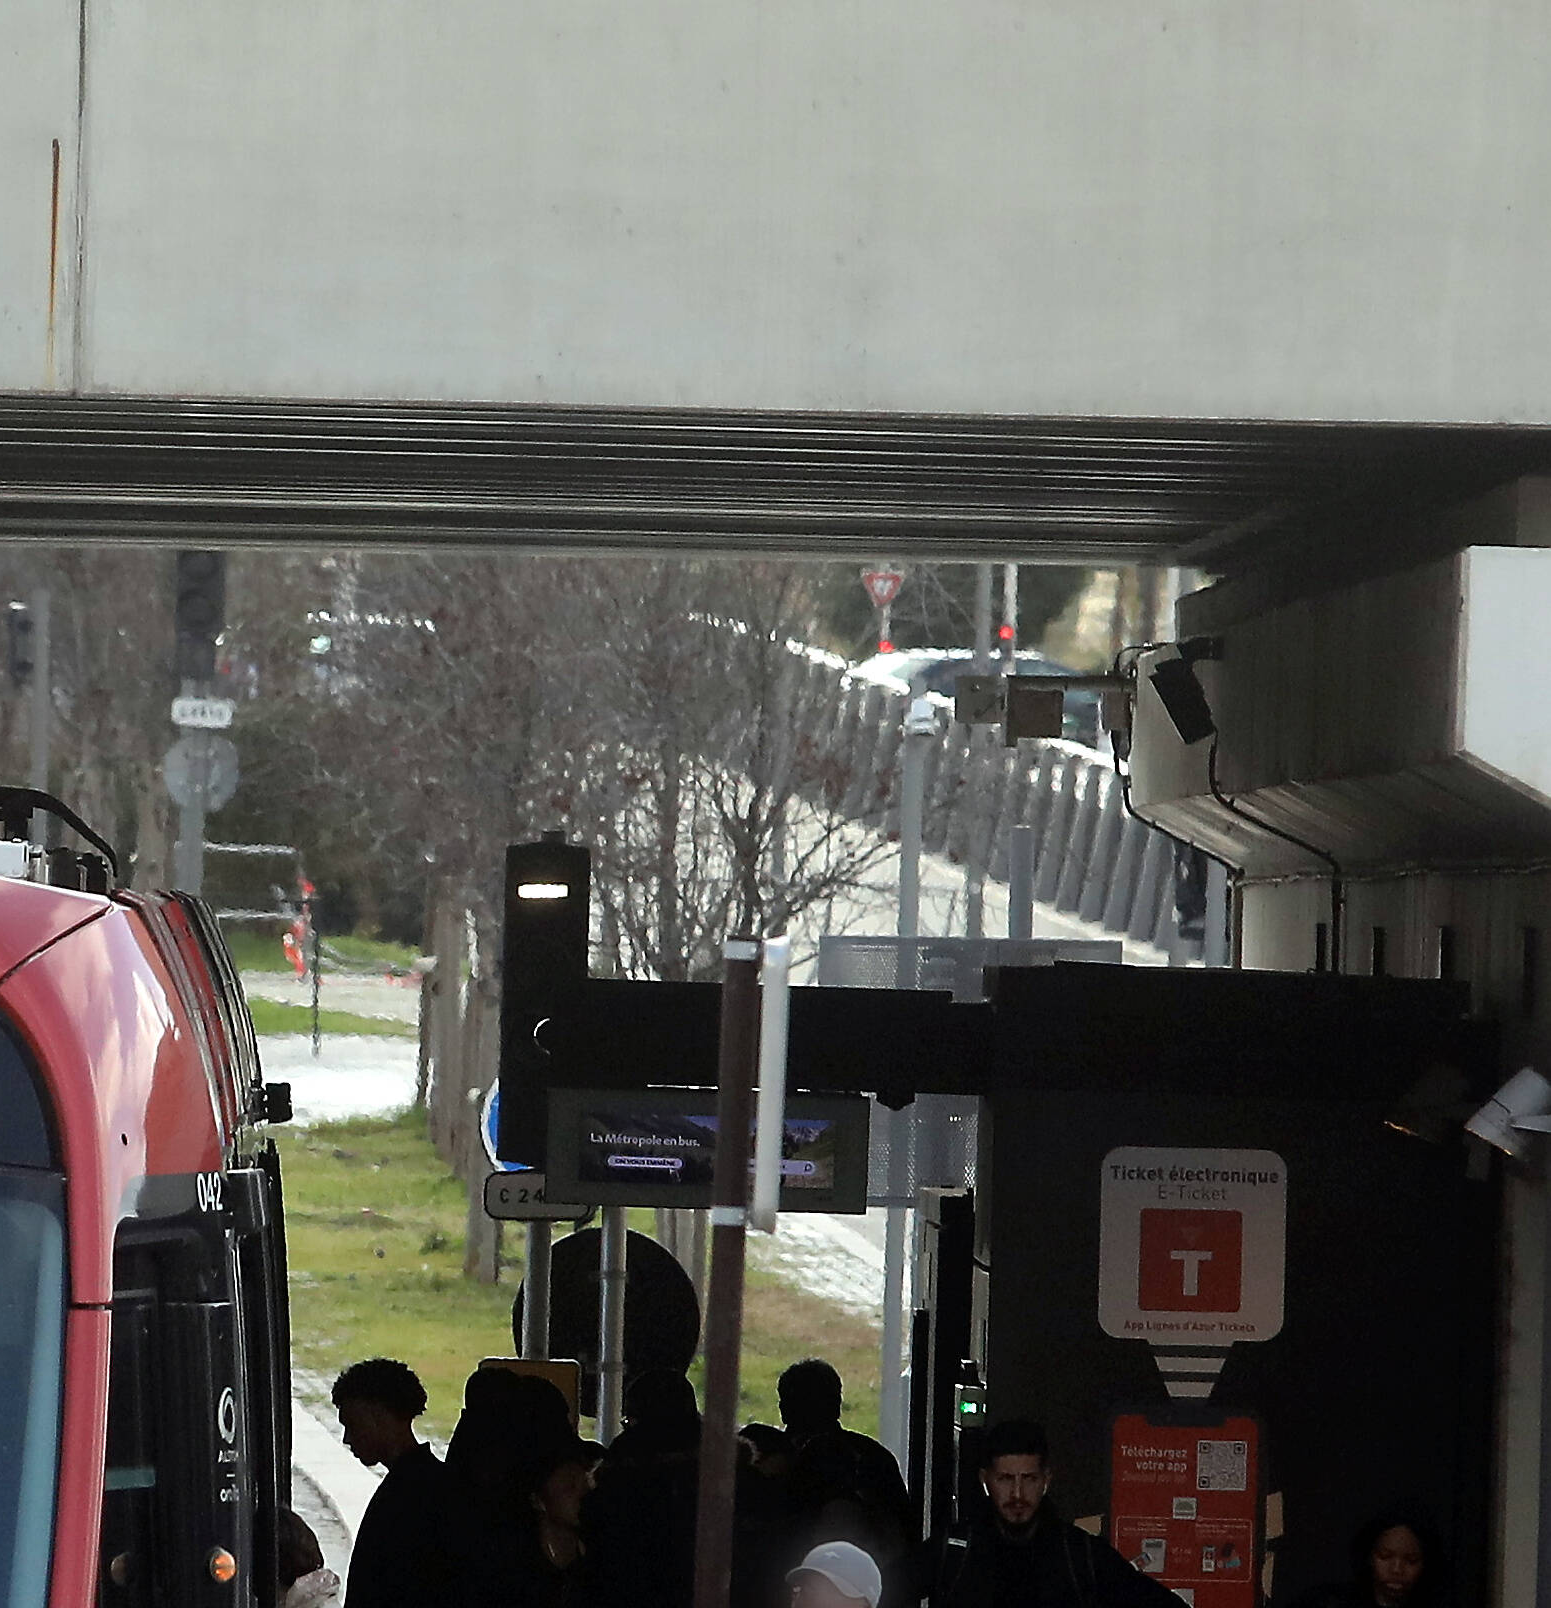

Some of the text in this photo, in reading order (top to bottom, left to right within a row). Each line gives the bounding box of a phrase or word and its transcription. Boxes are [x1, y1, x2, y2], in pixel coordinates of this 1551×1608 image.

[590, 1132, 603, 1144] La
[604, 1133, 662, 1148] Métropole
[663, 1138, 677, 1146] en
[1110, 1164, 1279, 1185] Ticket électronique
[196, 1171, 224, 1213] 042
[499, 1187, 509, 1204] C
[1158, 1184, 1228, 1200] E-Ticket
[1170, 1249, 1213, 1296] T
[1124, 1320, 1144, 1332] App
[1218, 1322, 1256, 1333] Tickets
[1121, 1444, 1188, 1459] Téléchargez
[1135, 1461, 1188, 1473] votre app
